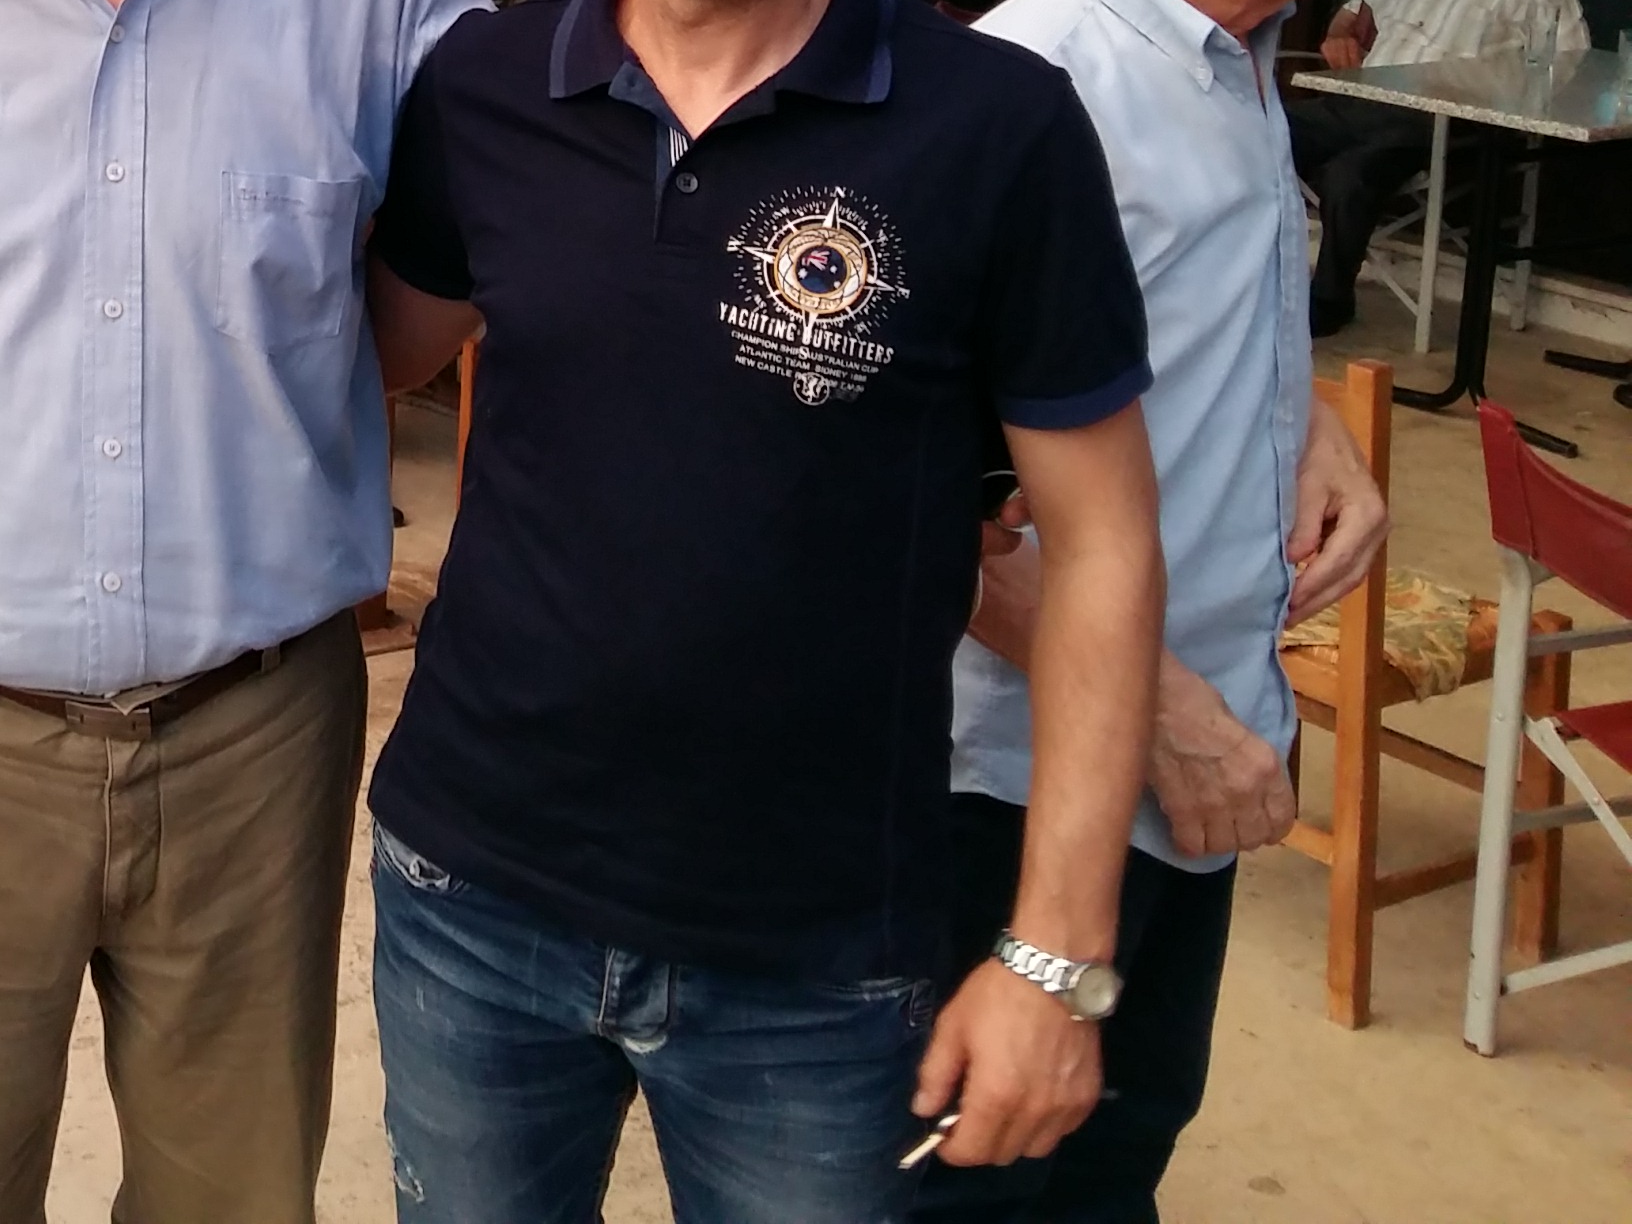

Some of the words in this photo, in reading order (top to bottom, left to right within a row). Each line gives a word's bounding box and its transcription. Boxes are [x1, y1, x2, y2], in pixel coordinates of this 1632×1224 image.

[719, 302, 796, 342] YACHTING
[801, 325, 894, 364] OUTFITTERS
[735, 354, 755, 368] NEW
[756, 361, 792, 378] CASTLE
[739, 344, 783, 363] ATLANTIC
[785, 356, 810, 371] TEAM
